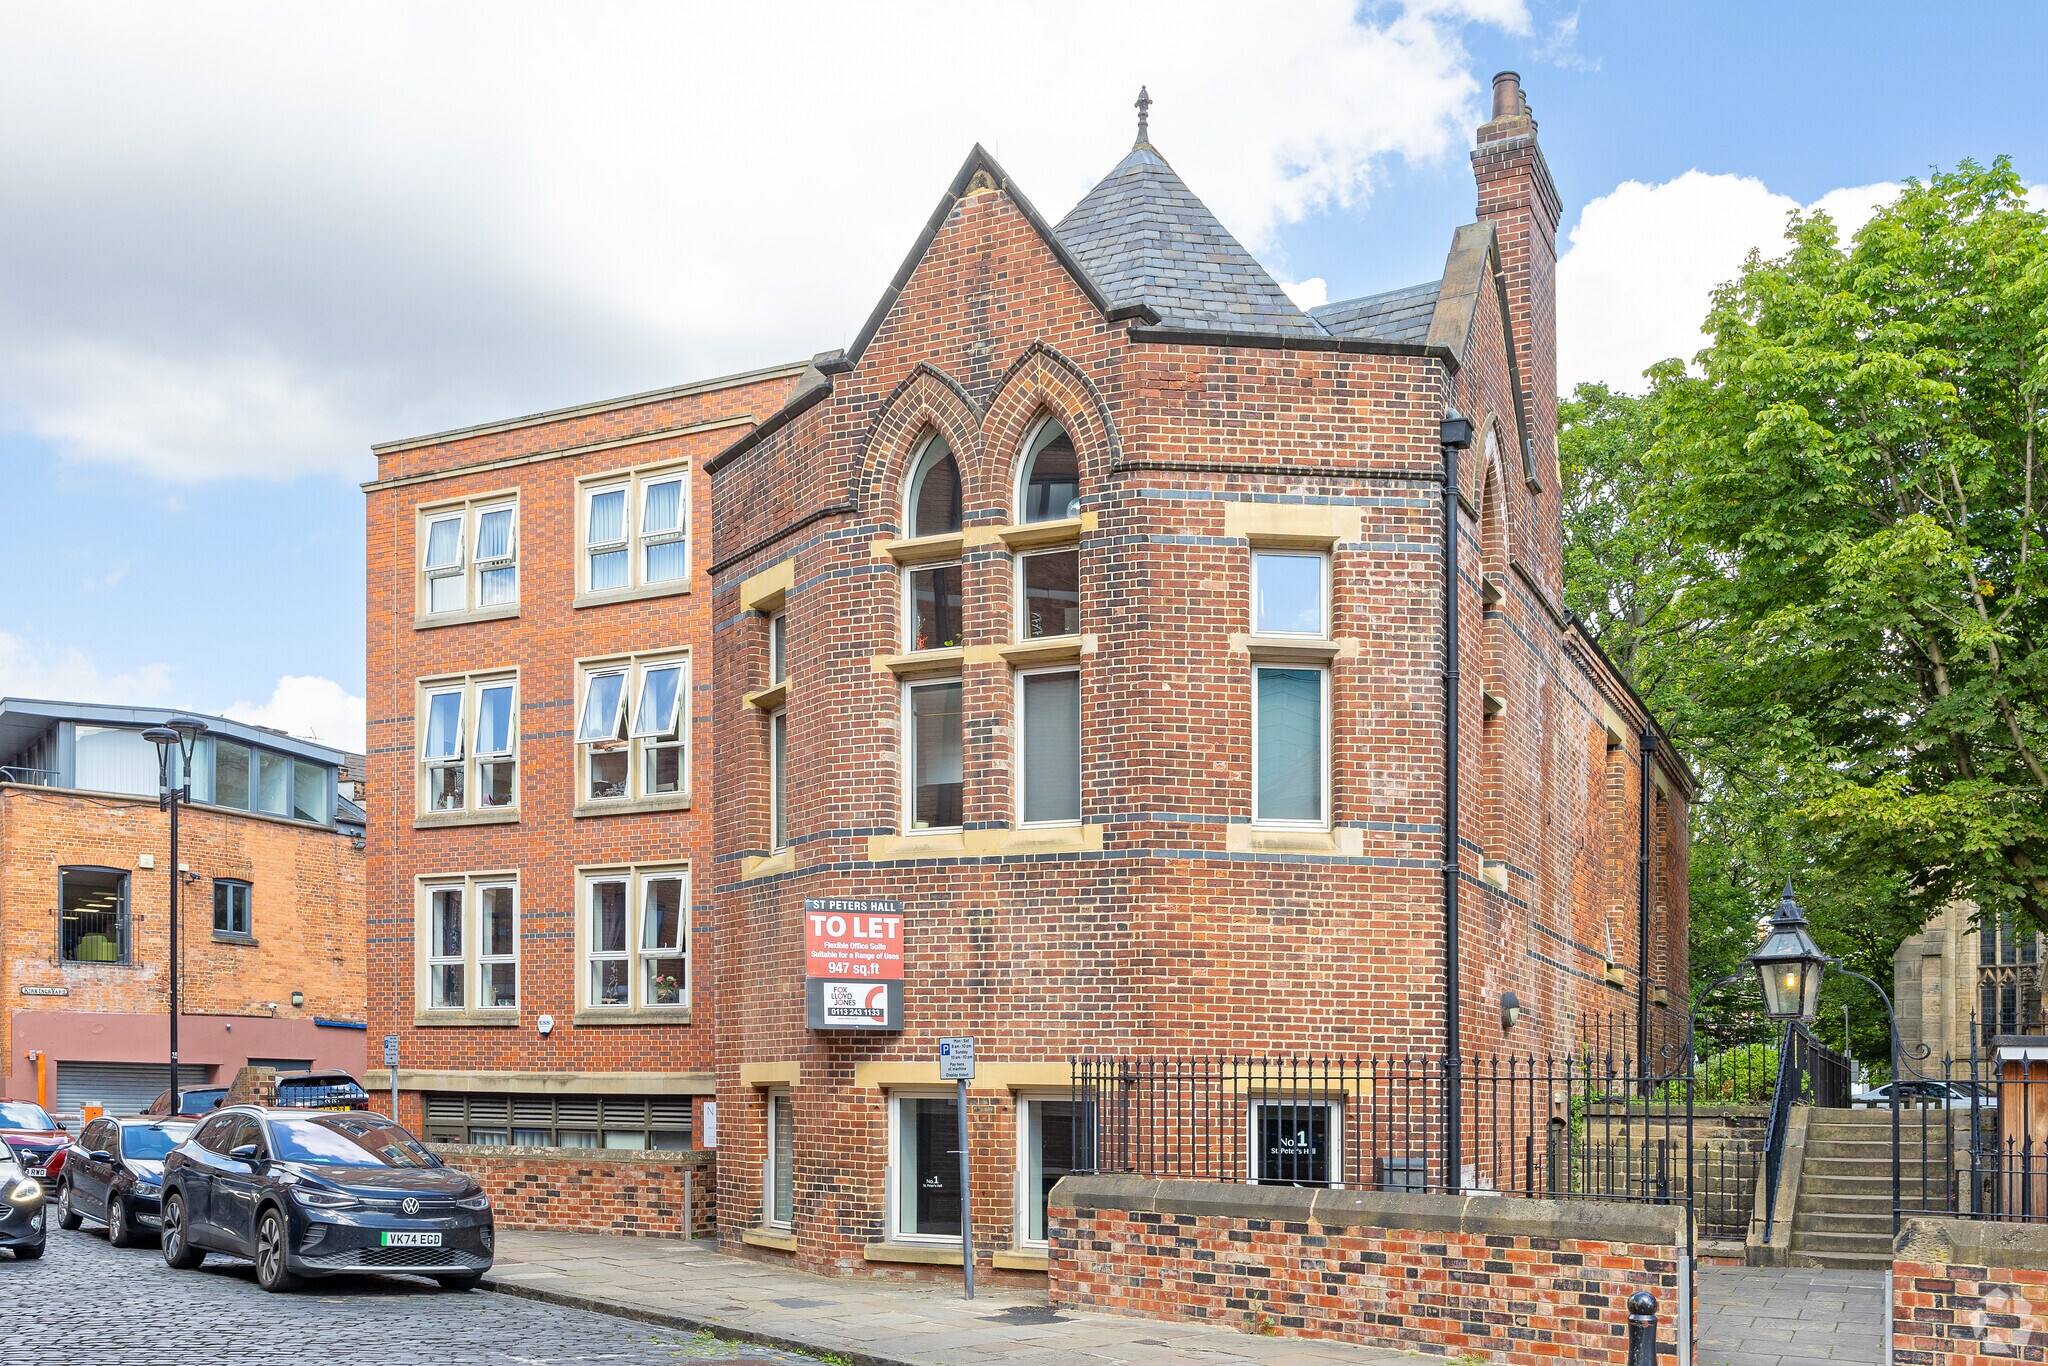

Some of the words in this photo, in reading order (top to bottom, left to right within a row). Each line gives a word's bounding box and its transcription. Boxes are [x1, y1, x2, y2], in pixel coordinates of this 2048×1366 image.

[814, 900, 825, 909] ST
[830, 901, 867, 911] PETERS
[871, 902, 896, 911] HALL
[809, 915, 847, 937] TO
[853, 916, 900, 939] LET
[828, 962, 850, 973] 947
[853, 962, 879, 976] sq.ft
[390, 1234, 417, 1244] VK74
[420, 1235, 440, 1244] EGD
